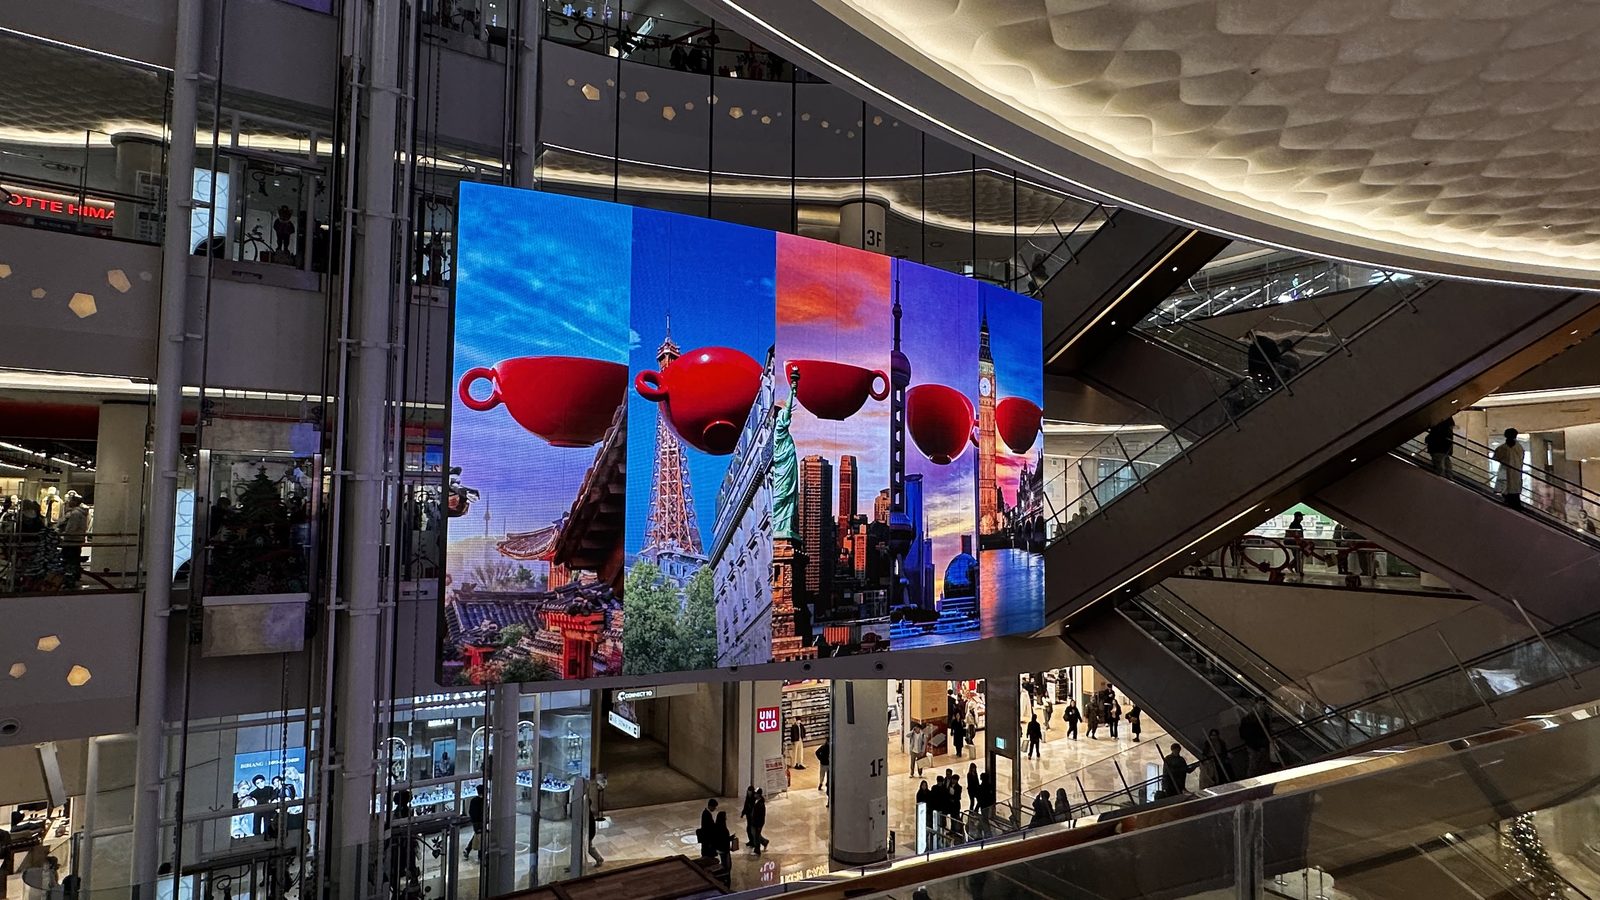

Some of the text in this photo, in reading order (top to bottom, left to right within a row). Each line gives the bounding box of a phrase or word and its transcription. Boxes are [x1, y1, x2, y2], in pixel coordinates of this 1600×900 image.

[7, 193, 63, 214] OTTE
[866, 229, 882, 248] 3F
[759, 709, 776, 720] UNI
[759, 719, 777, 731] QLO
[870, 758, 884, 778] 1F
